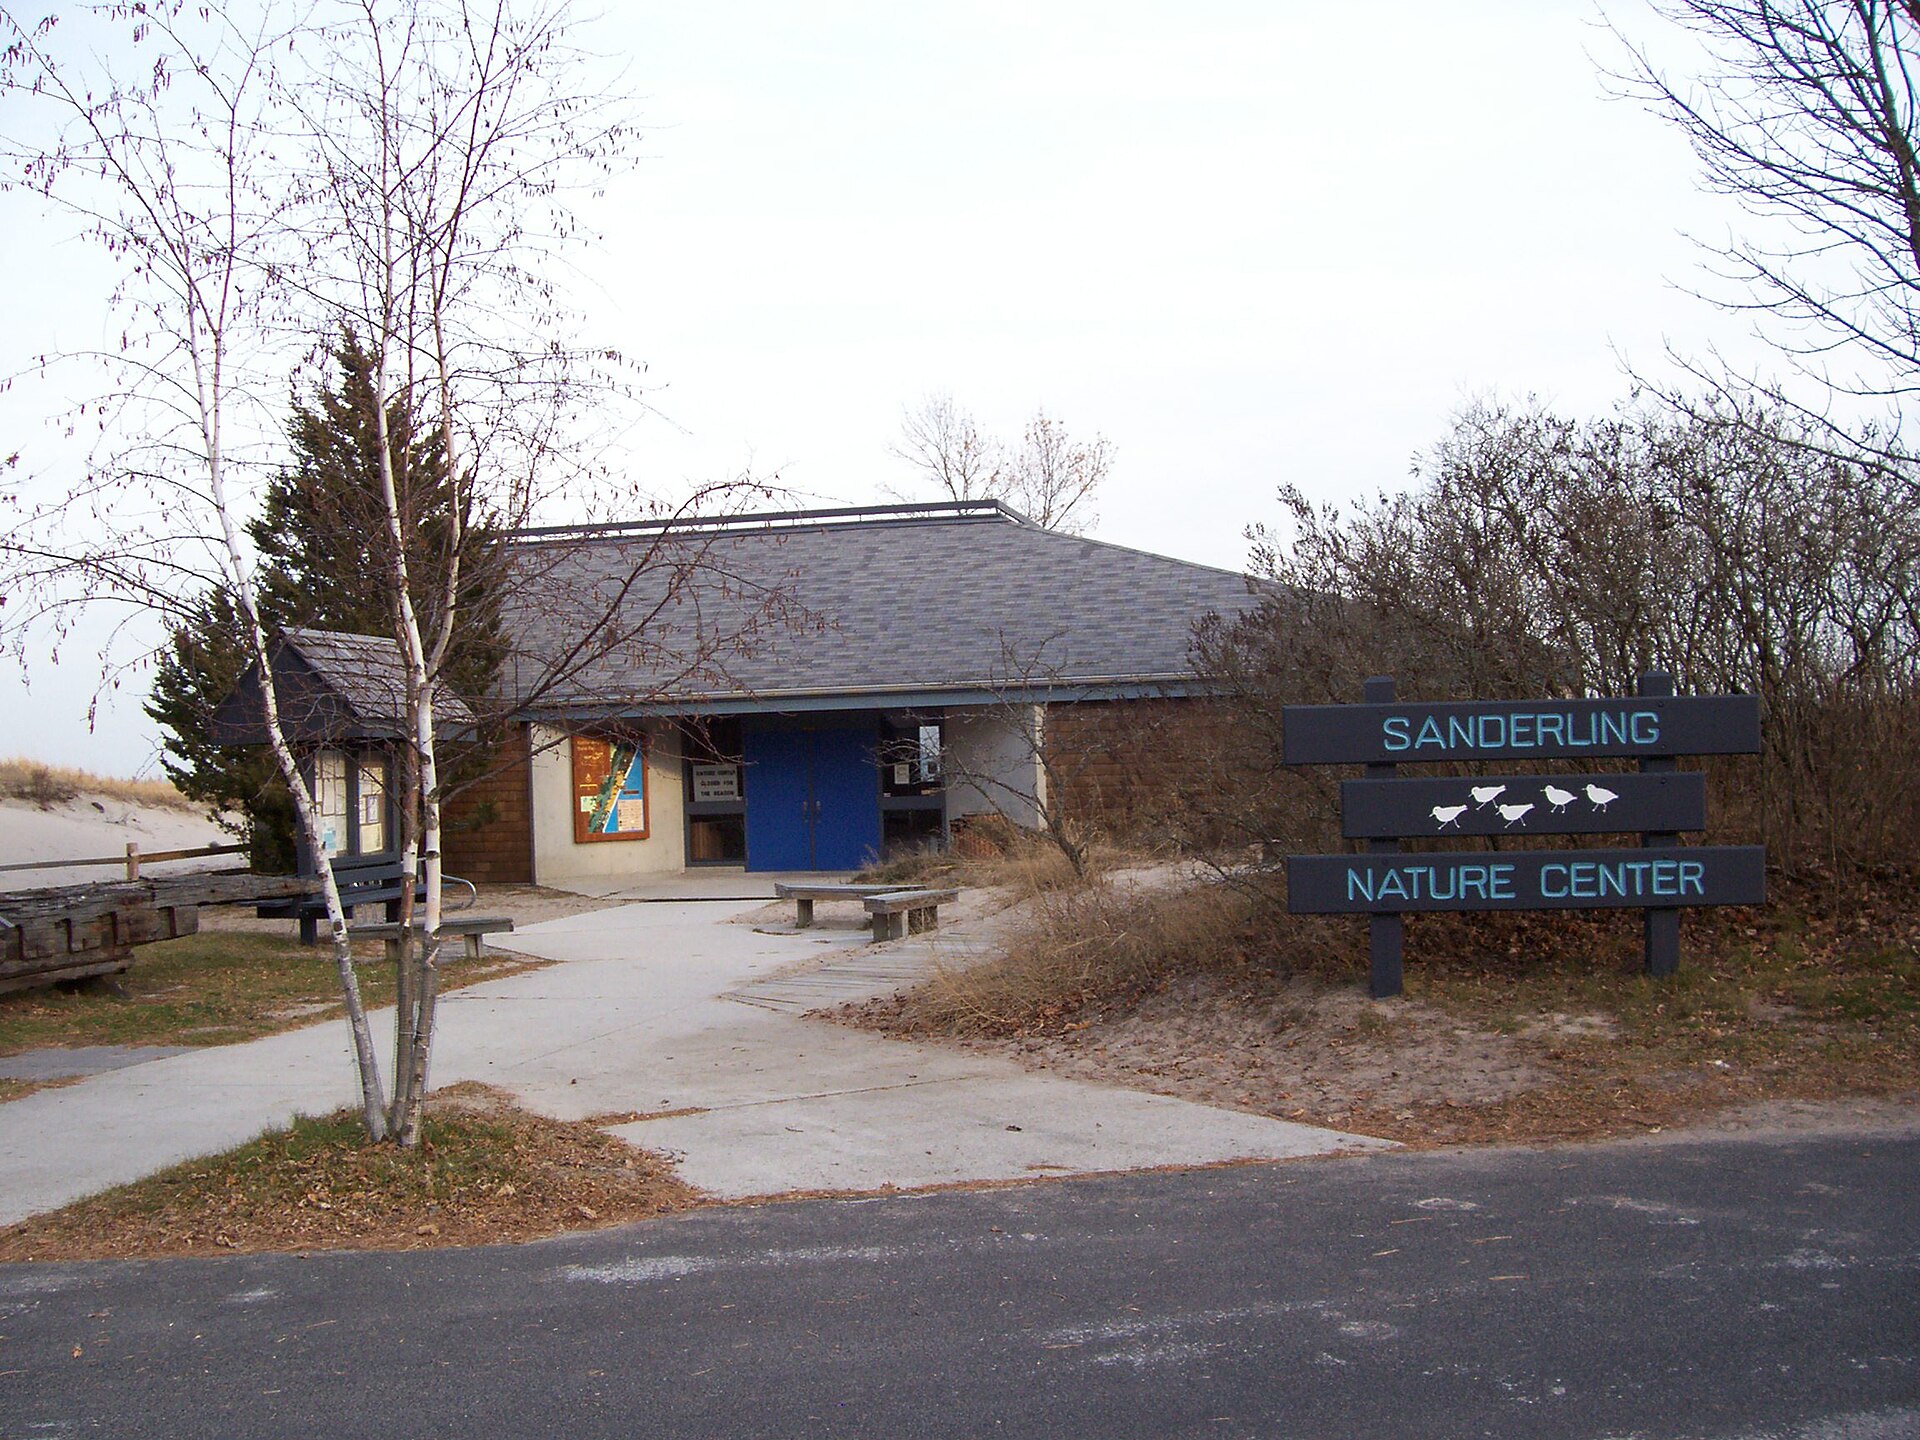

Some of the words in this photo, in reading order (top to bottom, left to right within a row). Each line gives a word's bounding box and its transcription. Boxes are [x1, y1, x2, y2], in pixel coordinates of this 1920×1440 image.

[1383, 711, 1660, 751] SANDERLING
[1347, 865, 1516, 902] NATURE
[1541, 860, 1704, 897] CENTER
